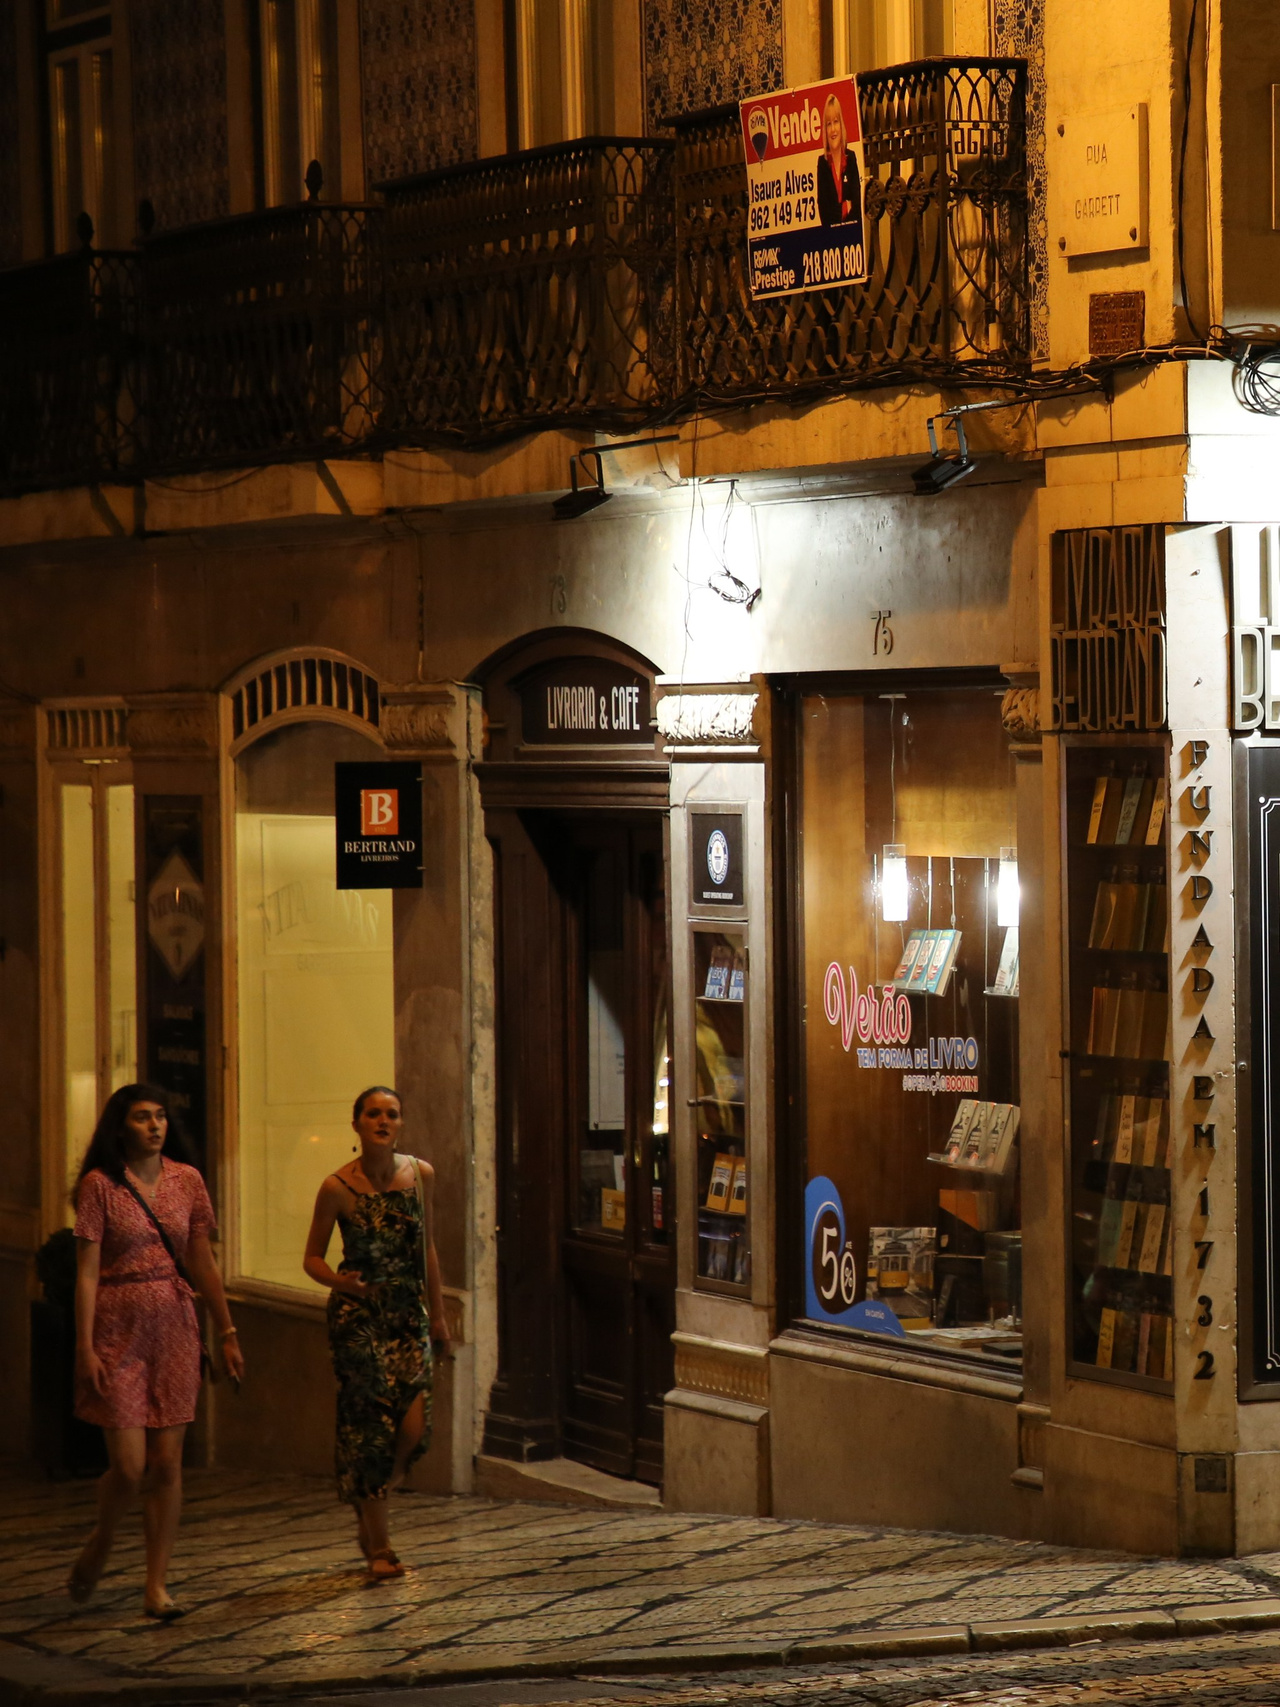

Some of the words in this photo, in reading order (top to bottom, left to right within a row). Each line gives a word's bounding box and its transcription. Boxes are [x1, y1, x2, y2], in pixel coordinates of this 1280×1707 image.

[767, 98, 821, 149] Vende
[1086, 145, 1108, 166] RUA
[750, 178, 782, 204] Isaura
[785, 169, 814, 196] Alves
[750, 205, 770, 232] 962
[773, 202, 792, 227] 149
[795, 196, 816, 222] 473
[1074, 193, 1121, 220] GARRETT
[754, 266, 795, 290] Prestige
[803, 251, 822, 284] 218
[823, 247, 842, 280] 800
[843, 243, 862, 278] 800
[1050, 526, 1166, 630] LIVRARIA
[870, 610, 894, 656] 75
[1049, 627, 1167, 730] BERTRAND
[547, 686, 596, 730] LIVRARIA
[599, 695, 609, 730] &
[368, 792, 394, 826] B
[344, 840, 416, 854] BERTRAND
[361, 854, 399, 862] LIVREIROS
[824, 961, 912, 1052] Verão
[857, 1048, 876, 1069] TEM
[878, 1048, 913, 1069] FORMA
[914, 1048, 928, 1069] DE
[929, 1037, 979, 1070] LIVRO
[1193, 1186, 1216, 1380] 1732
